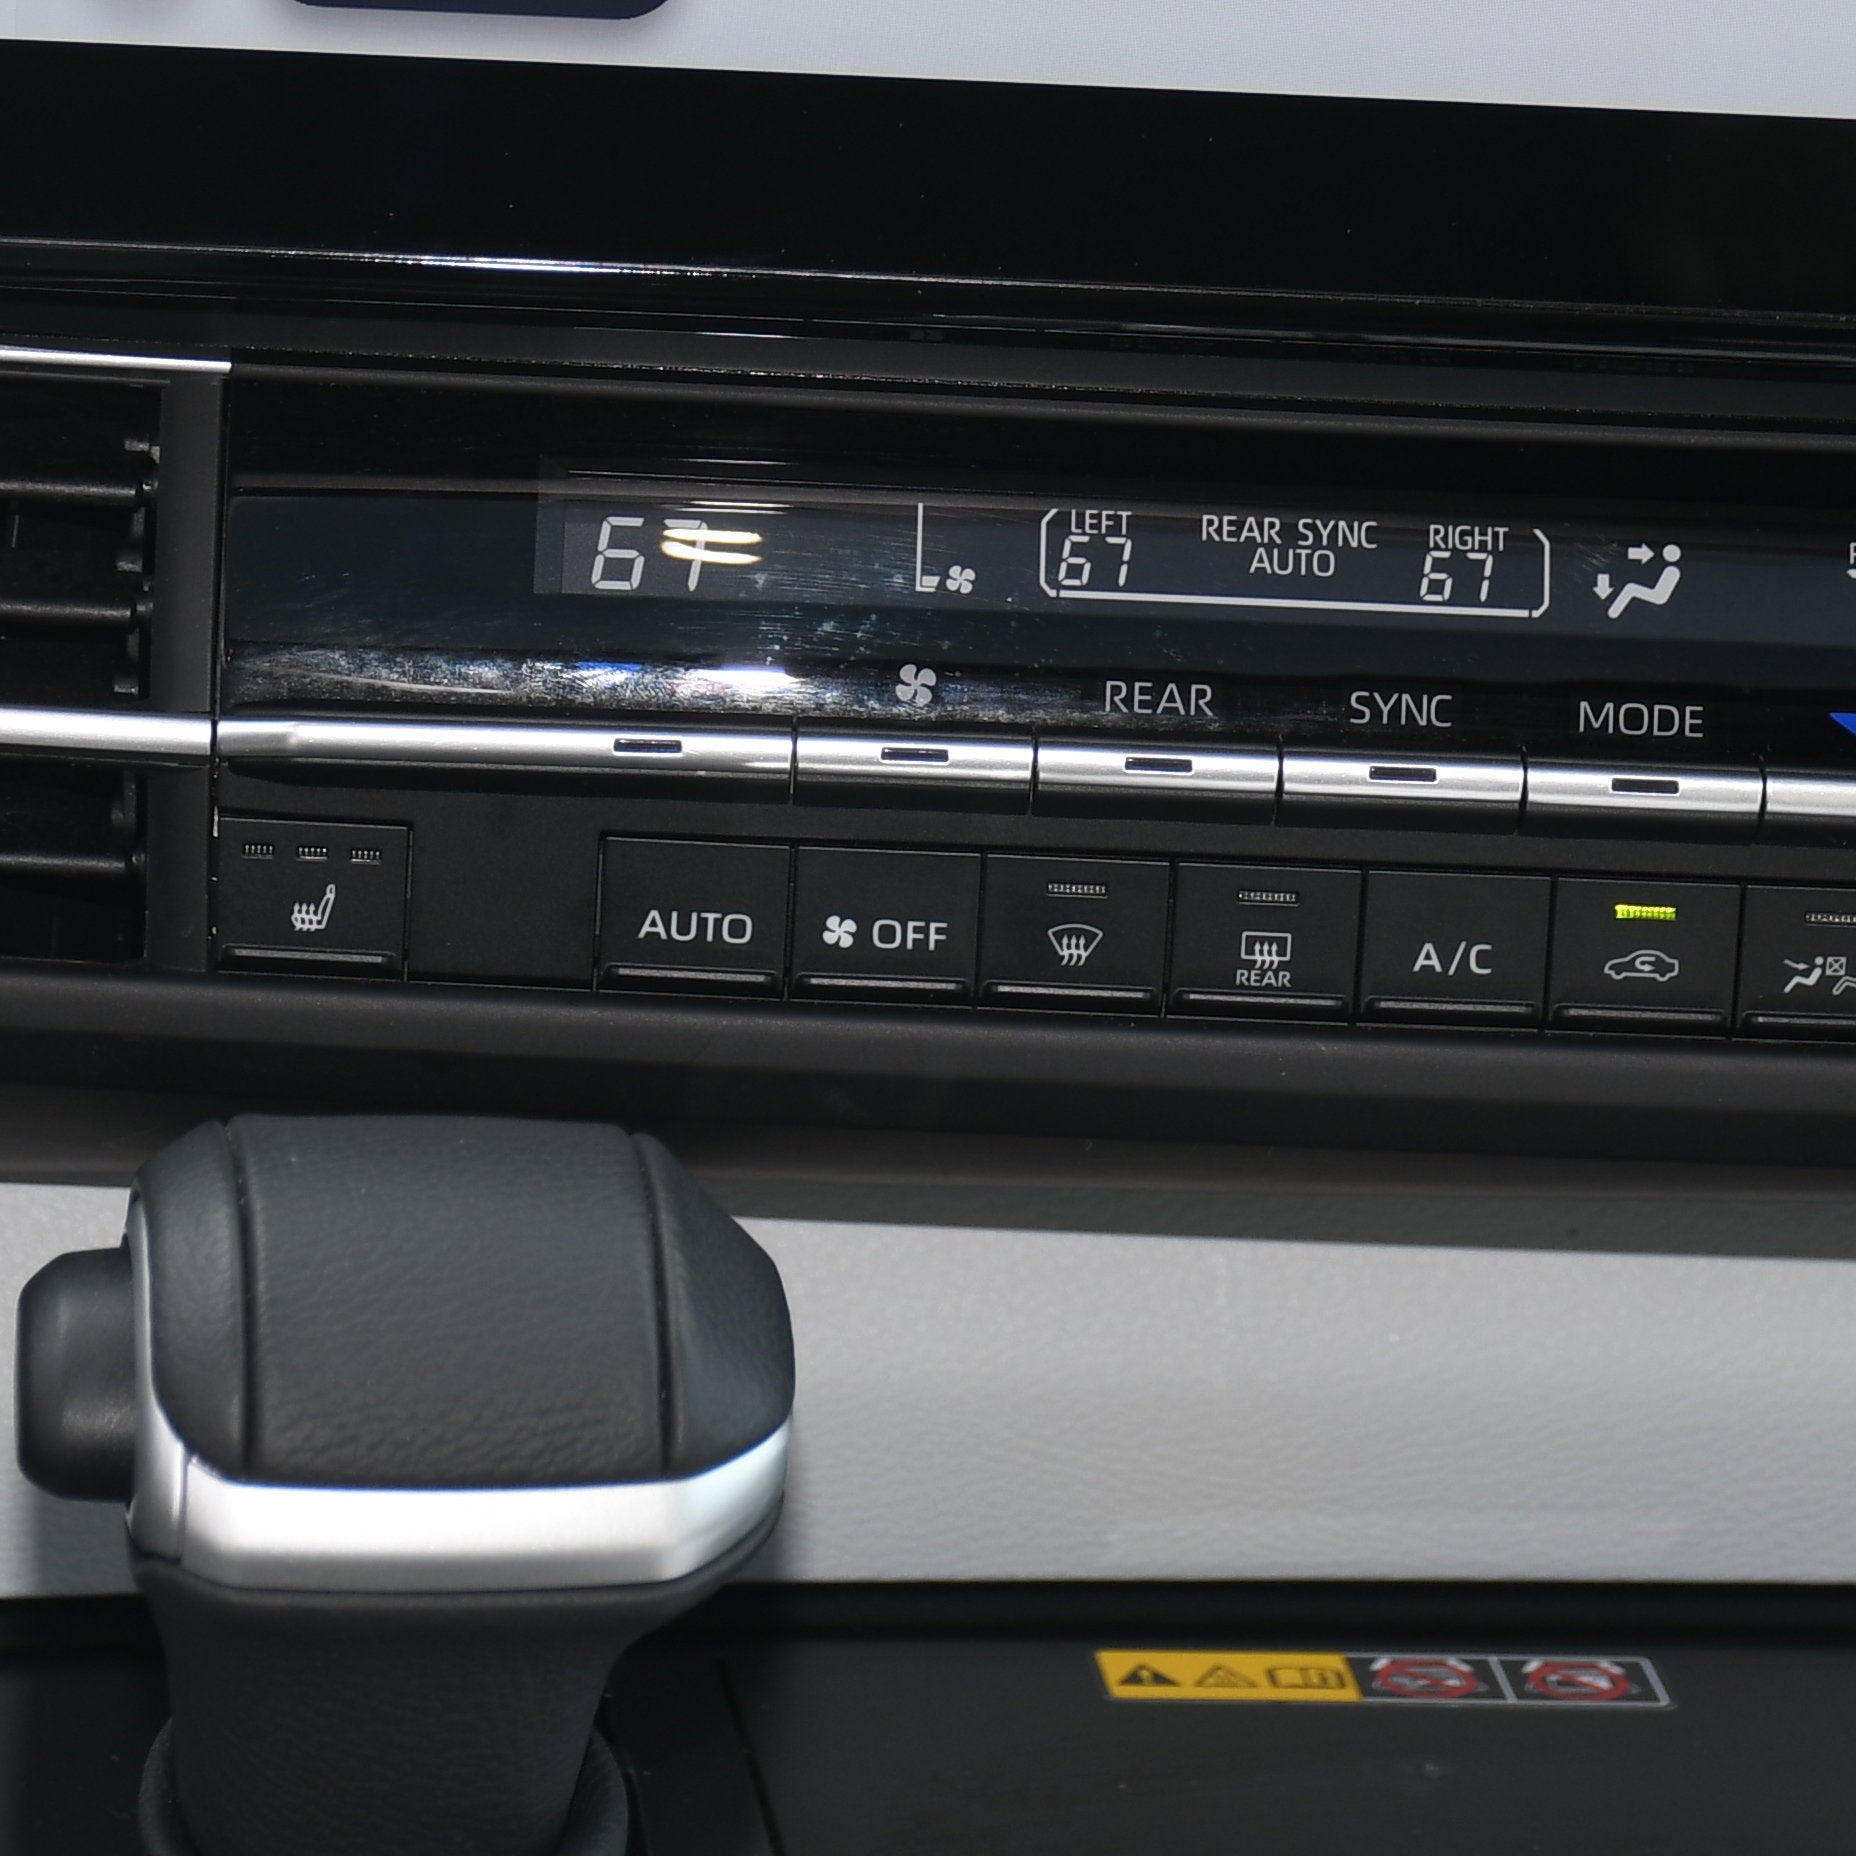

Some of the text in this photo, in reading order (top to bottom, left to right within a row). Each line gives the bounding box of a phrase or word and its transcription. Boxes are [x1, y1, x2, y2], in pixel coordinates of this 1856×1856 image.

[1068, 508, 1133, 535] LEFT
[1201, 514, 1378, 550] REAR SYNC
[1428, 524, 1509, 552] RIGHT
[591, 516, 709, 592] 67
[1057, 535, 1132, 587] 67
[1248, 546, 1336, 578] AUTO
[1419, 550, 1494, 603] 67
[1104, 681, 1214, 718] REAR
[1349, 690, 1453, 728] SYNC
[1579, 700, 1704, 738] MODE
[637, 909, 753, 945] AUTO
[872, 919, 948, 951] OFF
[1412, 941, 1492, 976] A/C
[1235, 969, 1292, 989] REAR
